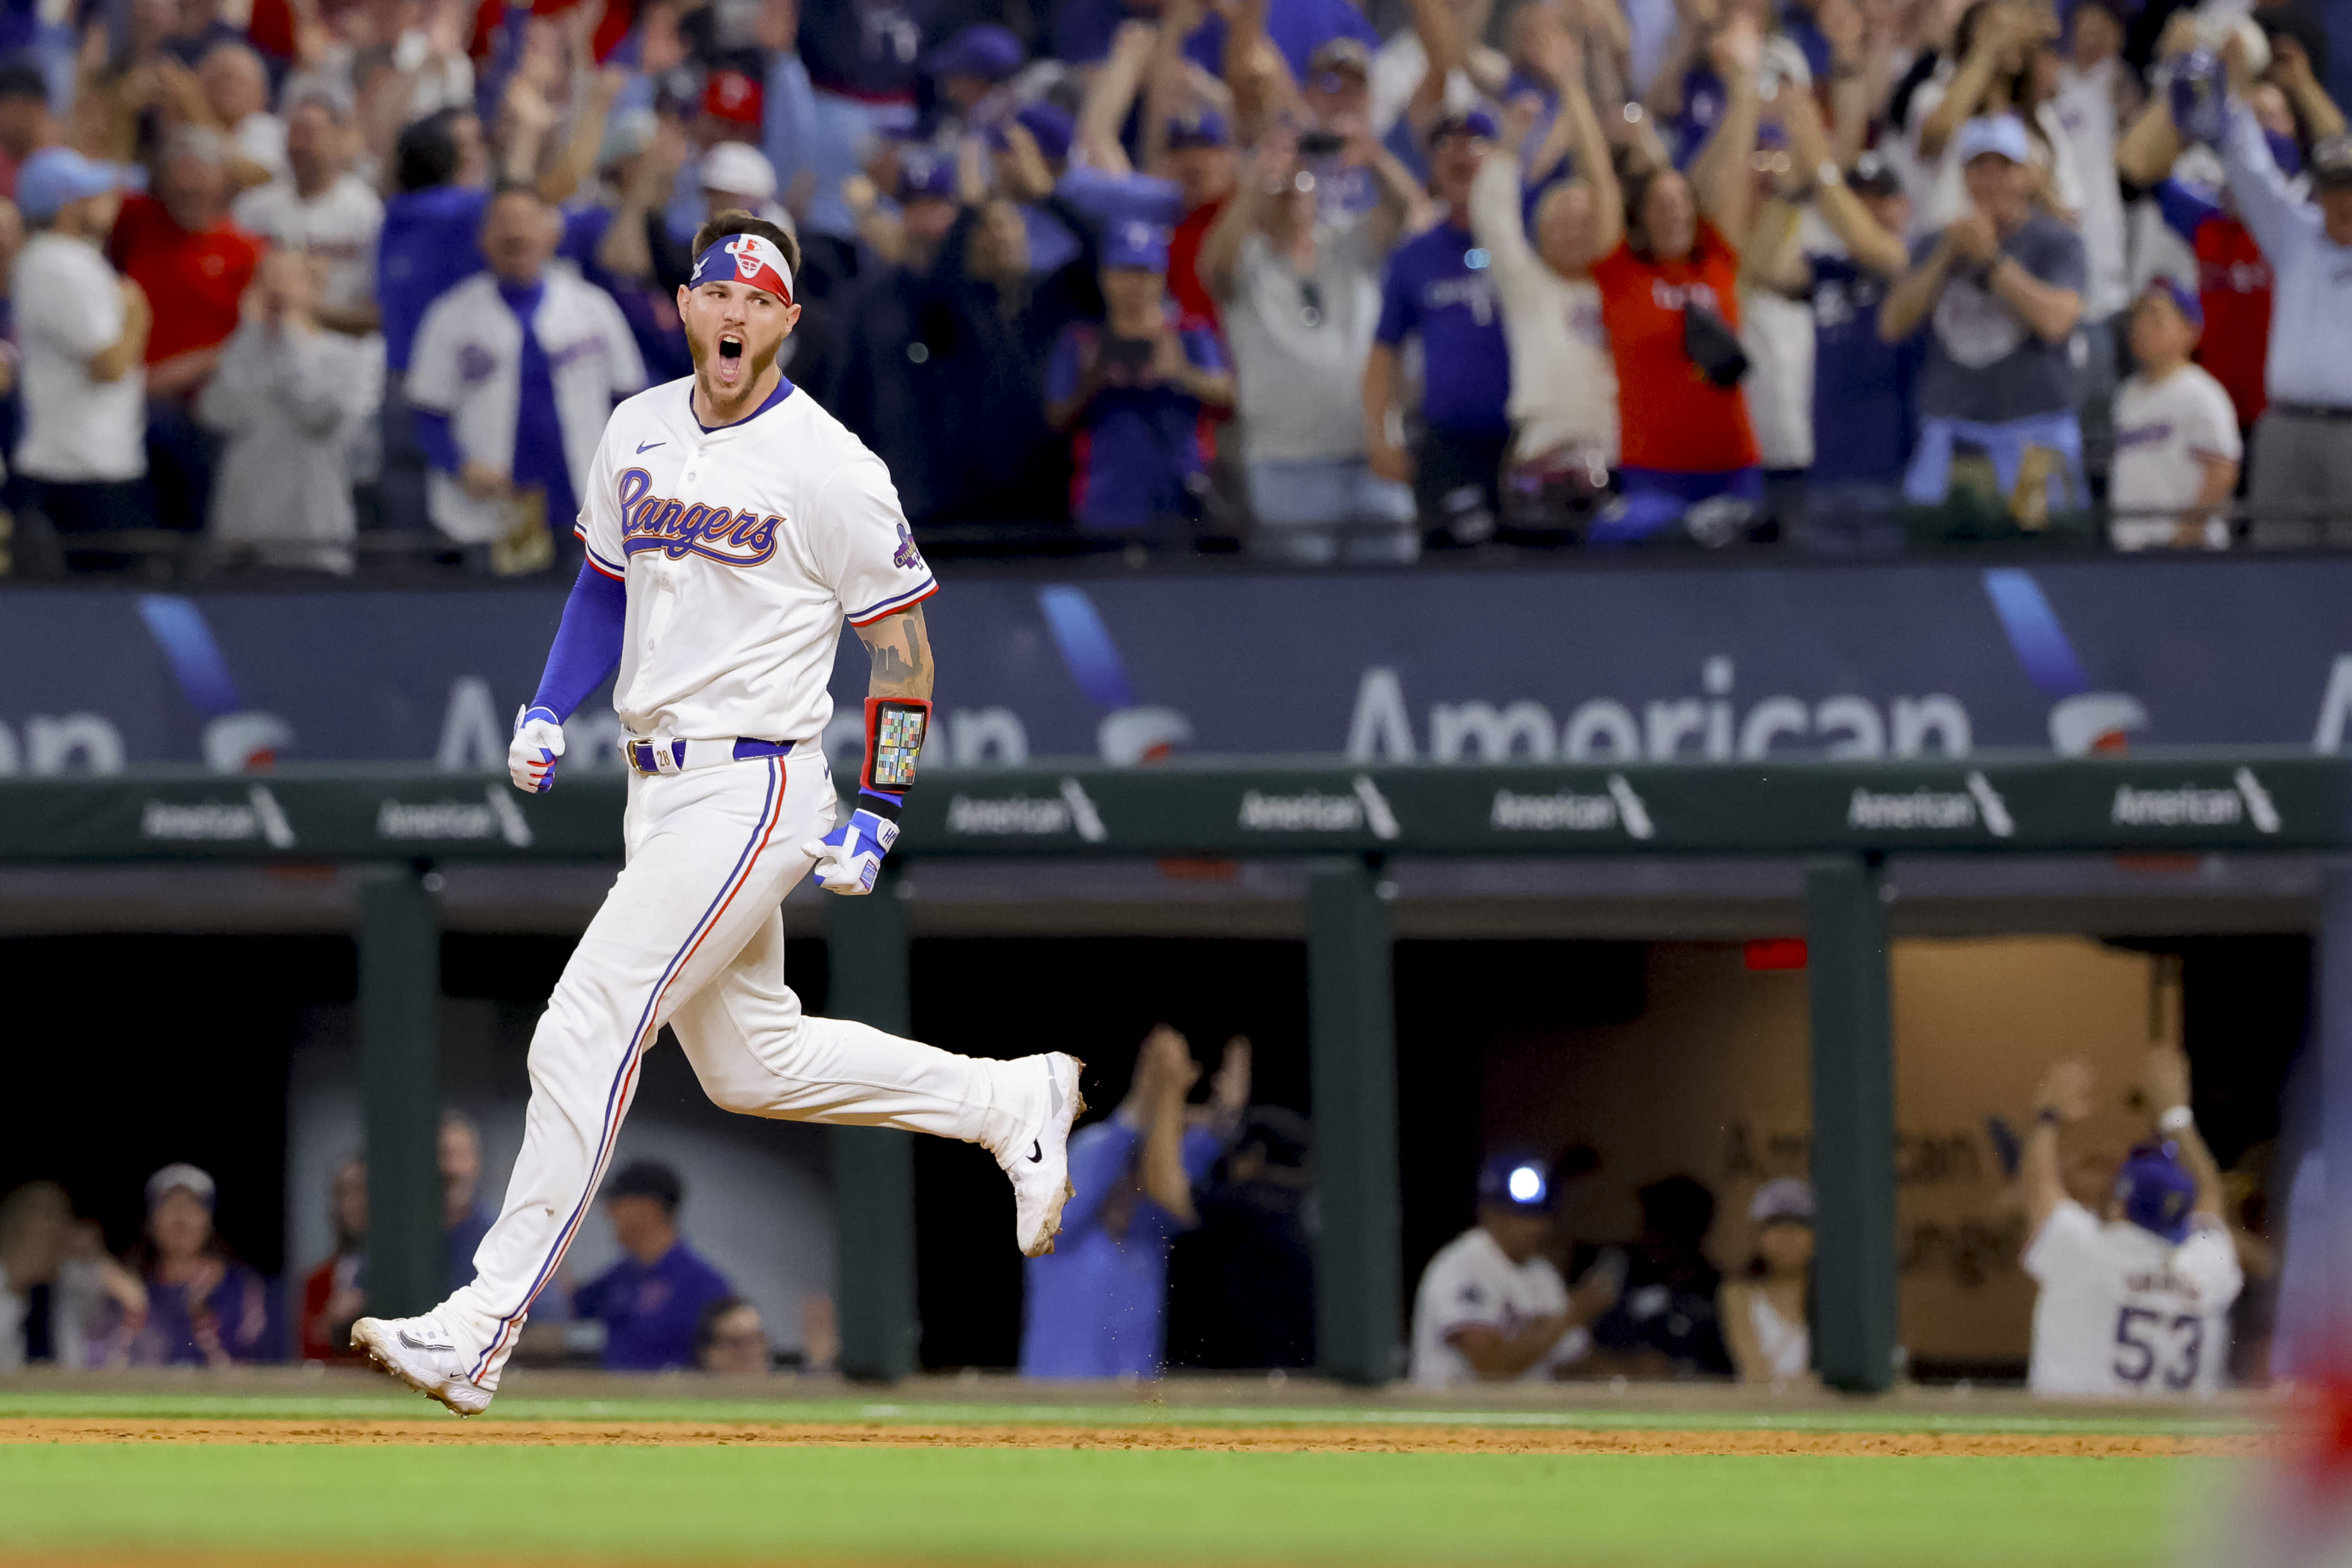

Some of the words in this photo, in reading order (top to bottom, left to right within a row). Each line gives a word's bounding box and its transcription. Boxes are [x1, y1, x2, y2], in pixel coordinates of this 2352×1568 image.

[619, 467, 786, 568] Rangers
[656, 750, 671, 767] 28
[2114, 1305, 2205, 1390] 53
